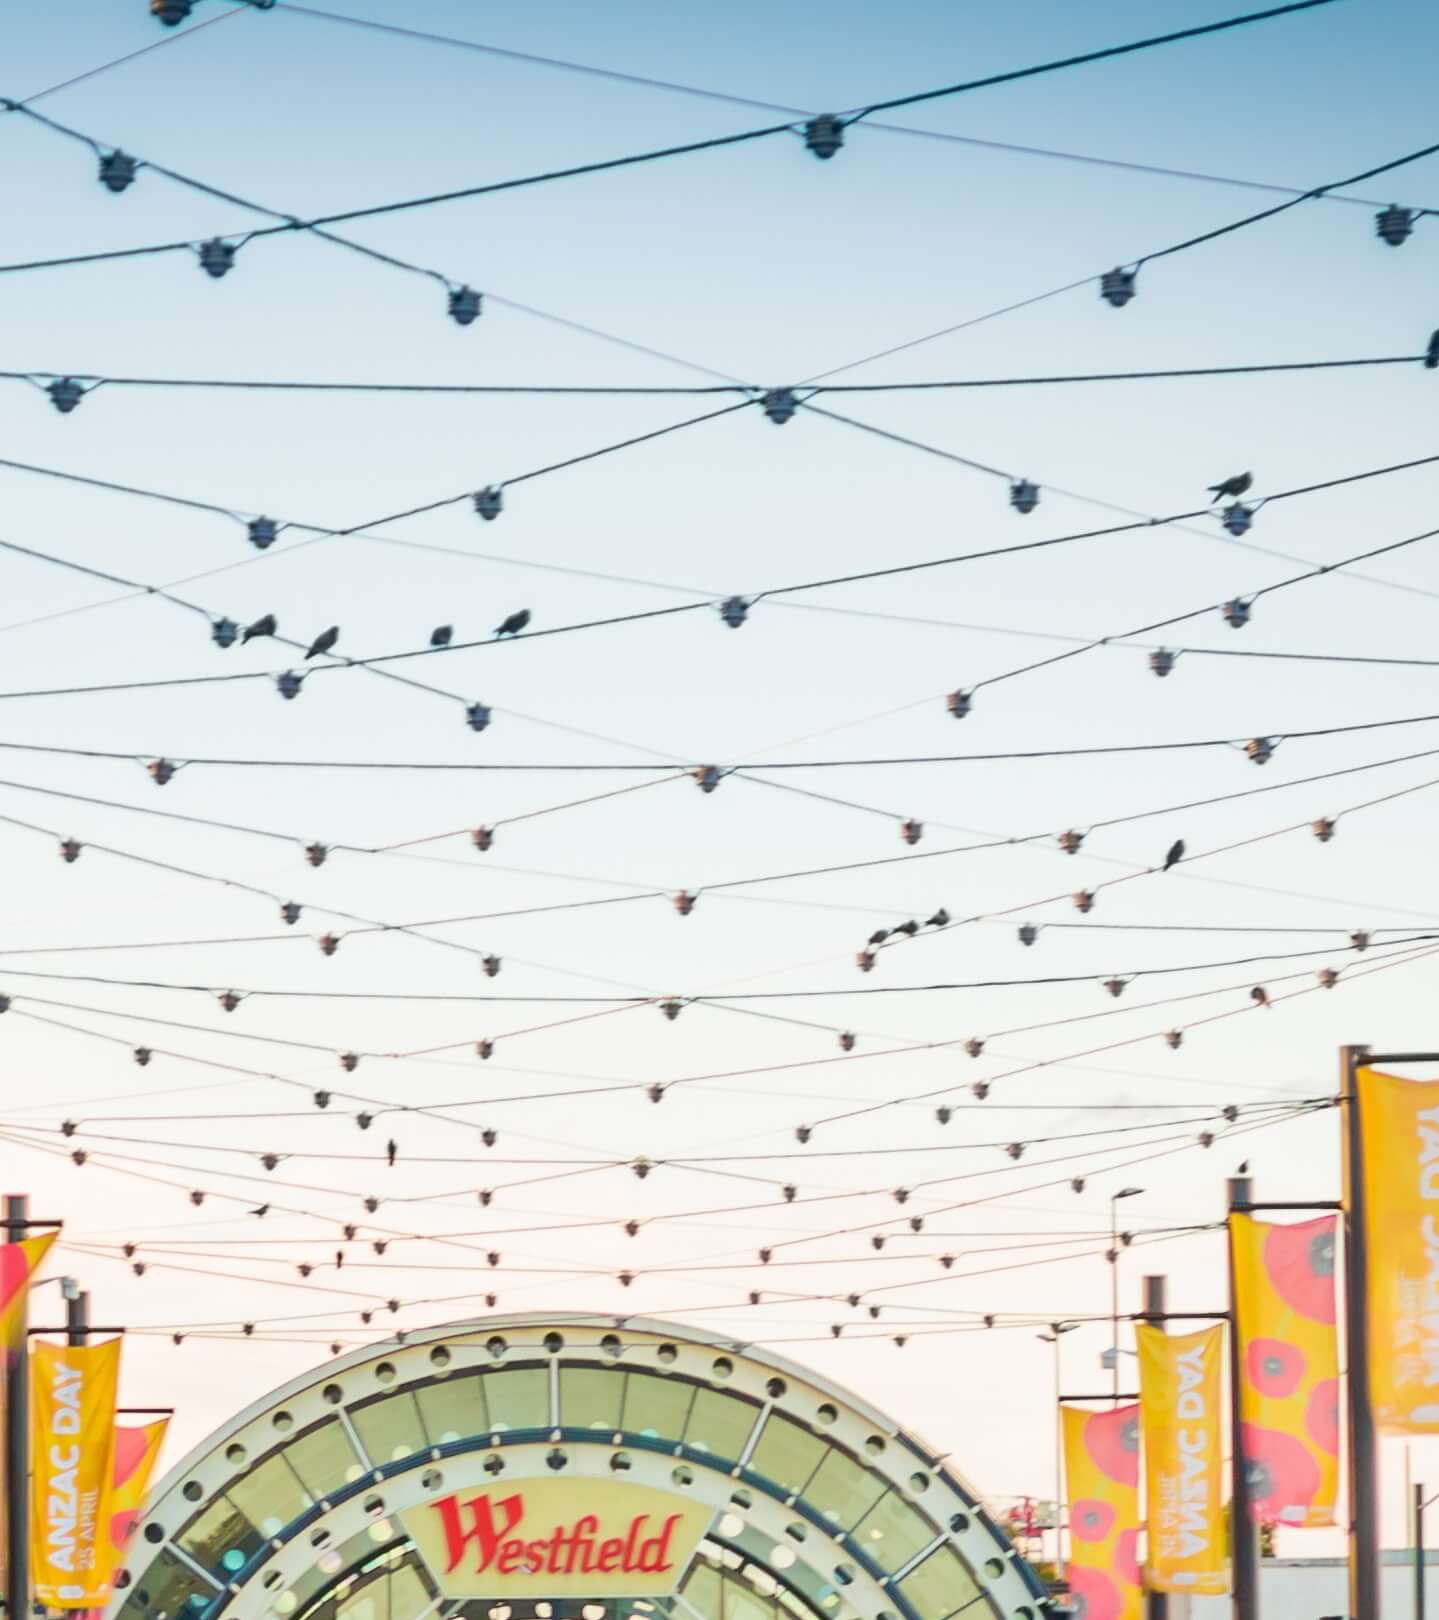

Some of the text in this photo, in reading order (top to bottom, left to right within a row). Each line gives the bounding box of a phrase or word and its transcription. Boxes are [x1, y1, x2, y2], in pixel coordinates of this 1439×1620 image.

[48, 1361, 83, 1573] ANZAC DAY
[79, 1487, 99, 1543] APRIL
[429, 1493, 684, 1574] Westfield
